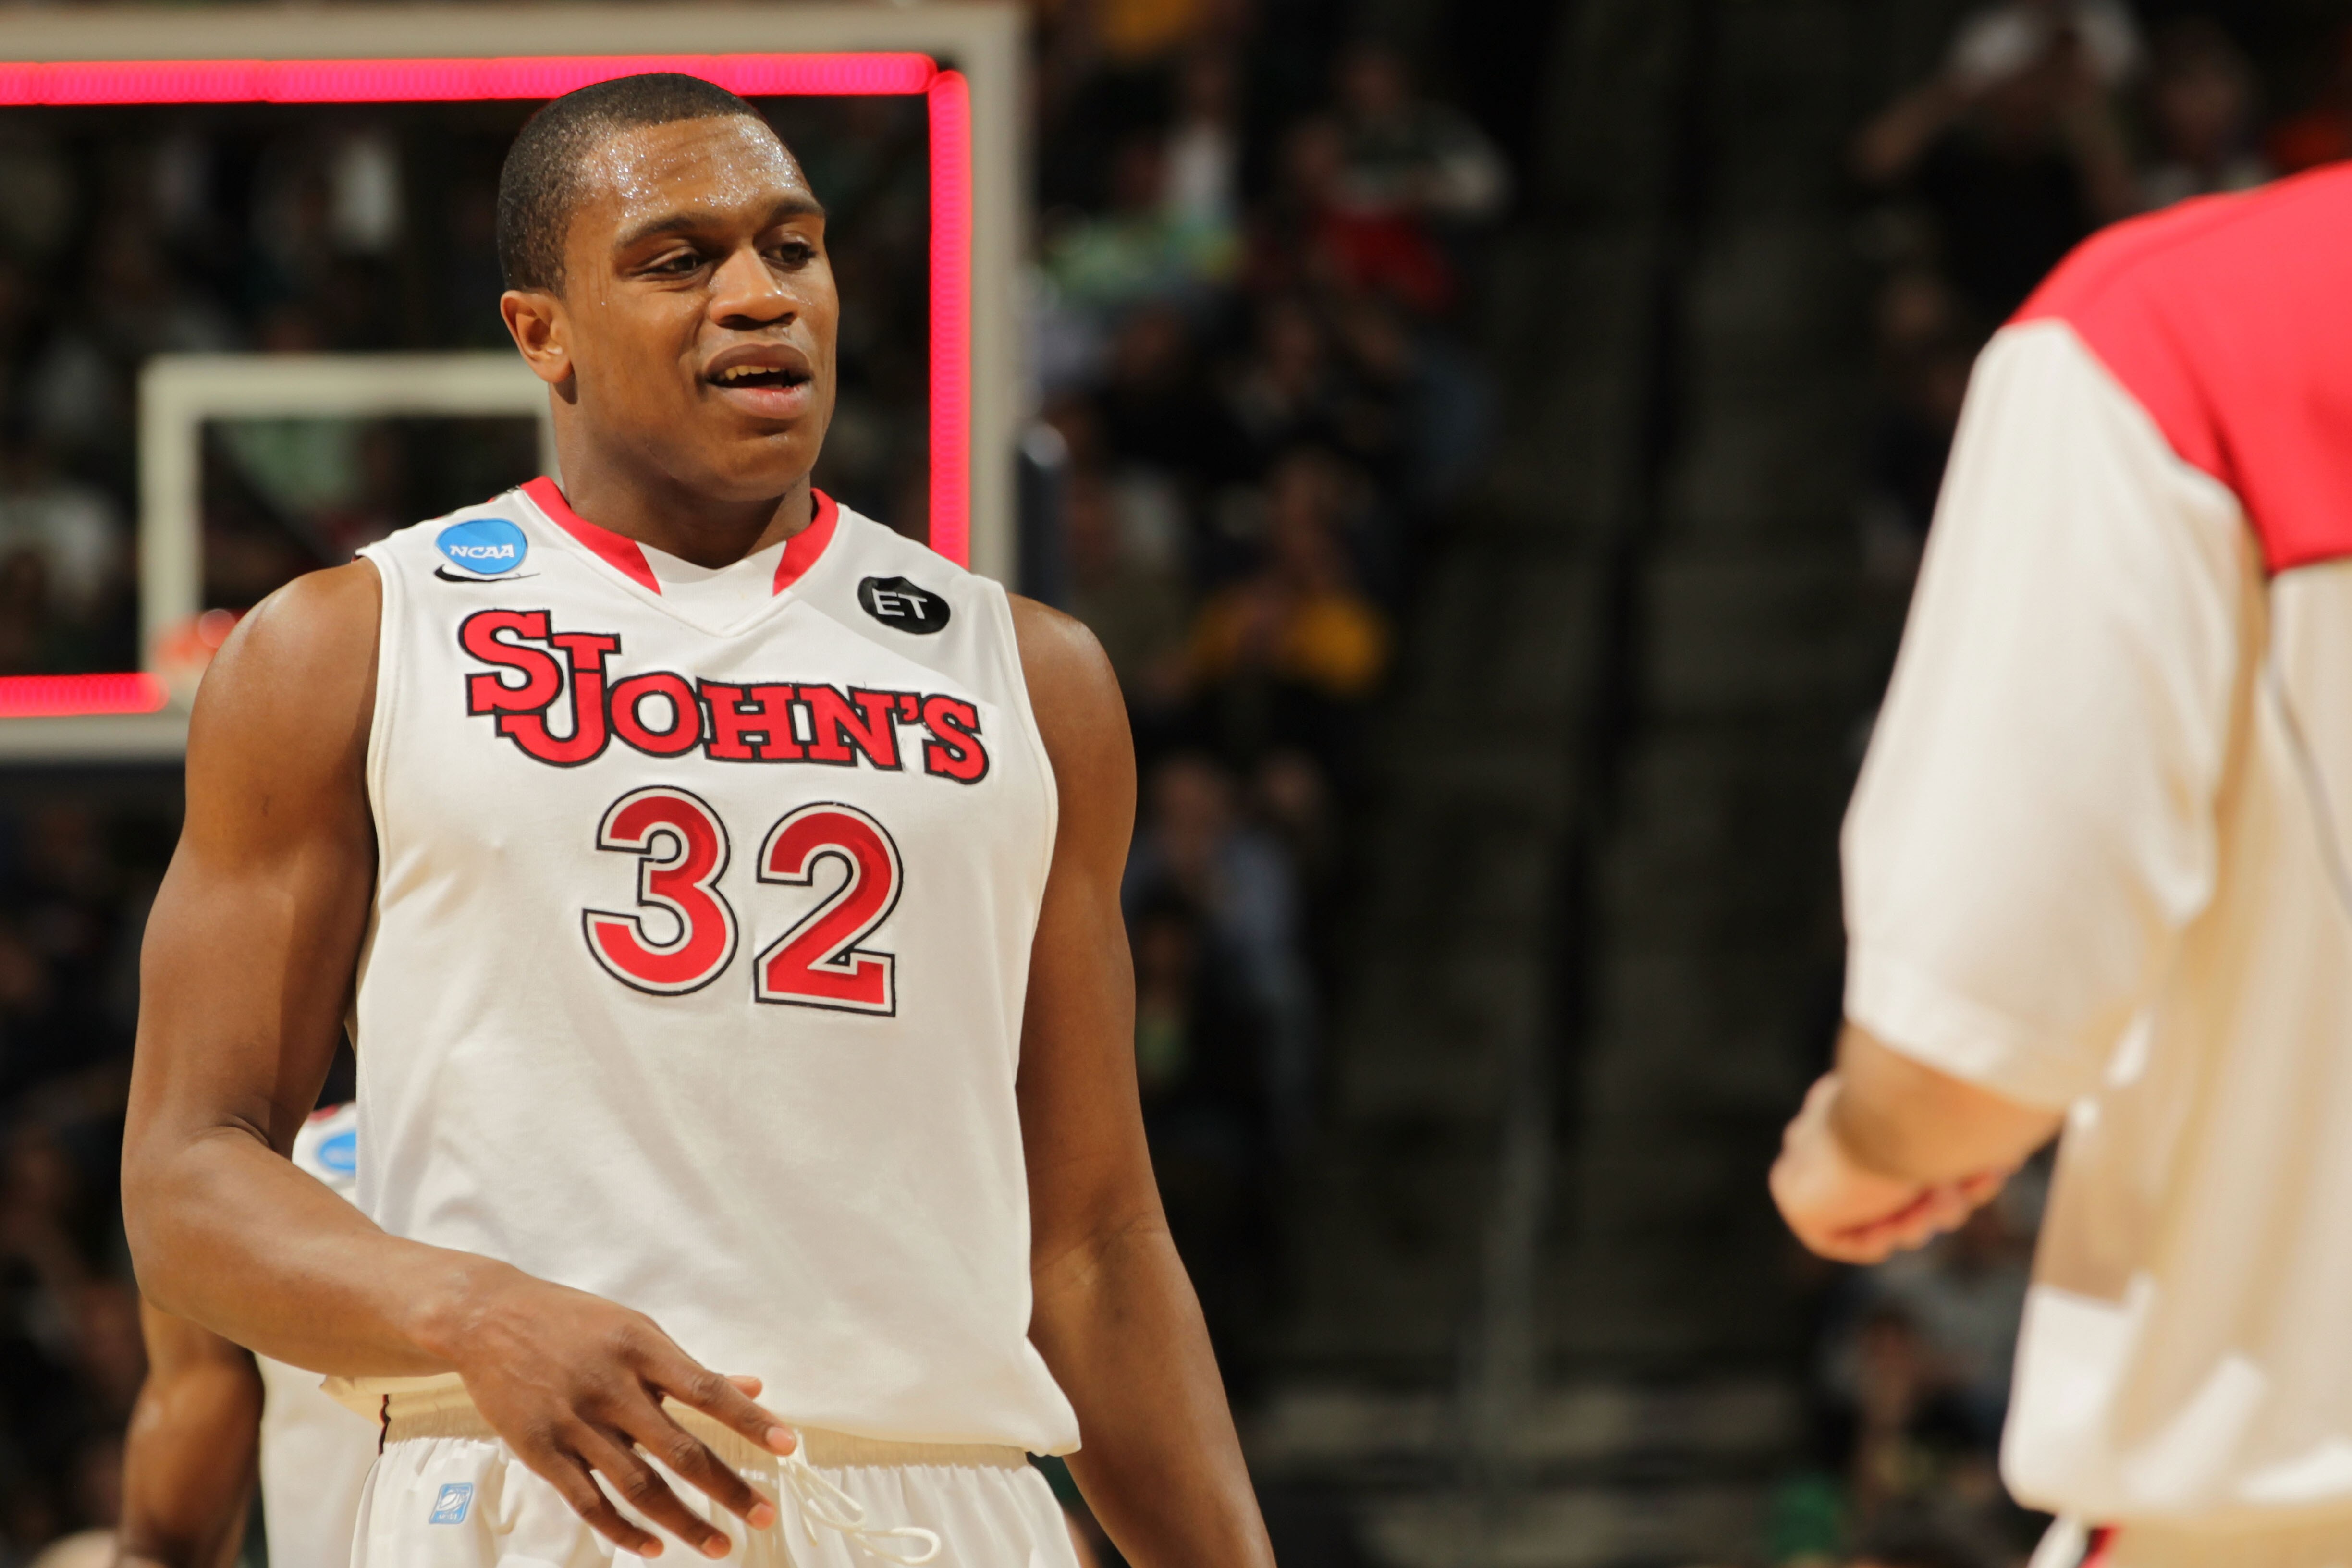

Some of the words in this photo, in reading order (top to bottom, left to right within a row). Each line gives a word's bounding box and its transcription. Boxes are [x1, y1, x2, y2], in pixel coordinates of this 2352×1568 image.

[449, 543, 514, 559] NCAA
[872, 588, 928, 619] ET
[581, 784, 904, 1017] 32
